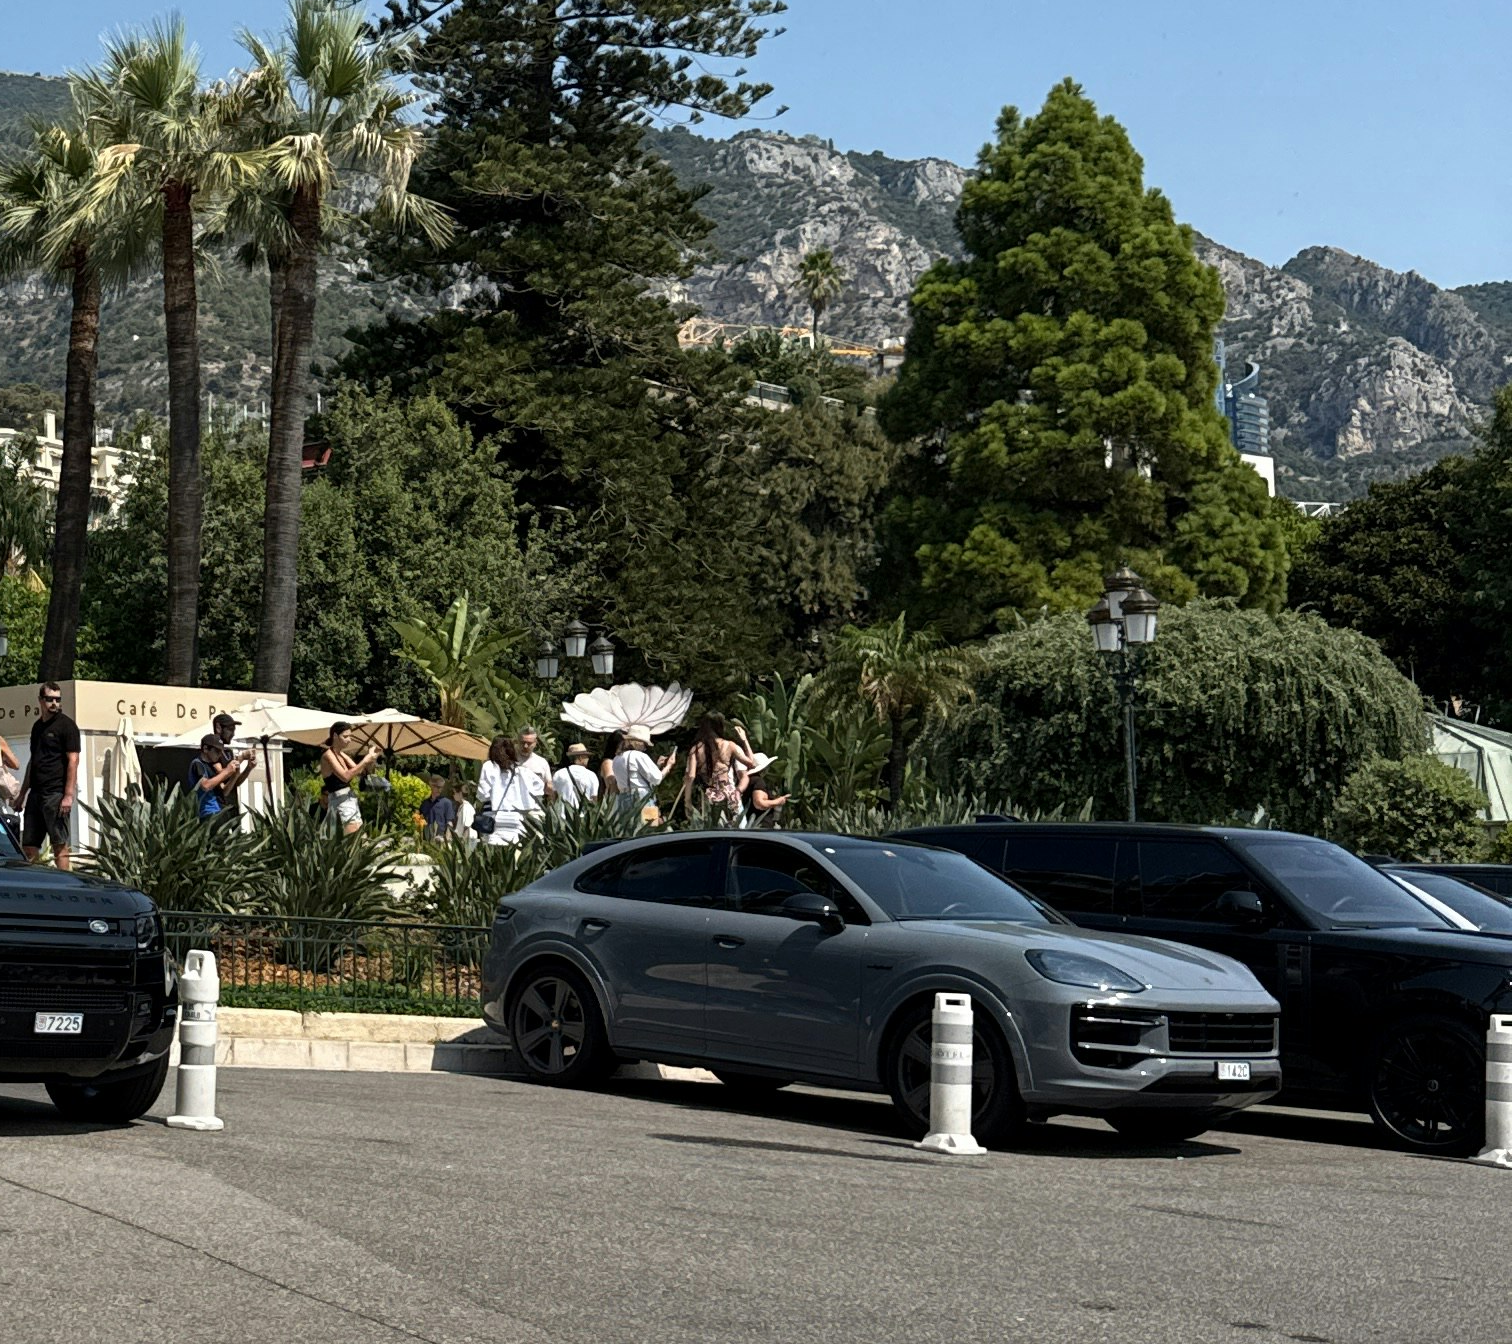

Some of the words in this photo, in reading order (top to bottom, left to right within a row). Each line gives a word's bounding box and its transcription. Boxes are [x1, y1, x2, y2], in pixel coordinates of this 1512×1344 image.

[116, 699, 157, 717] Café
[176, 703, 198, 719] De
[46, 1016, 81, 1032] 7225
